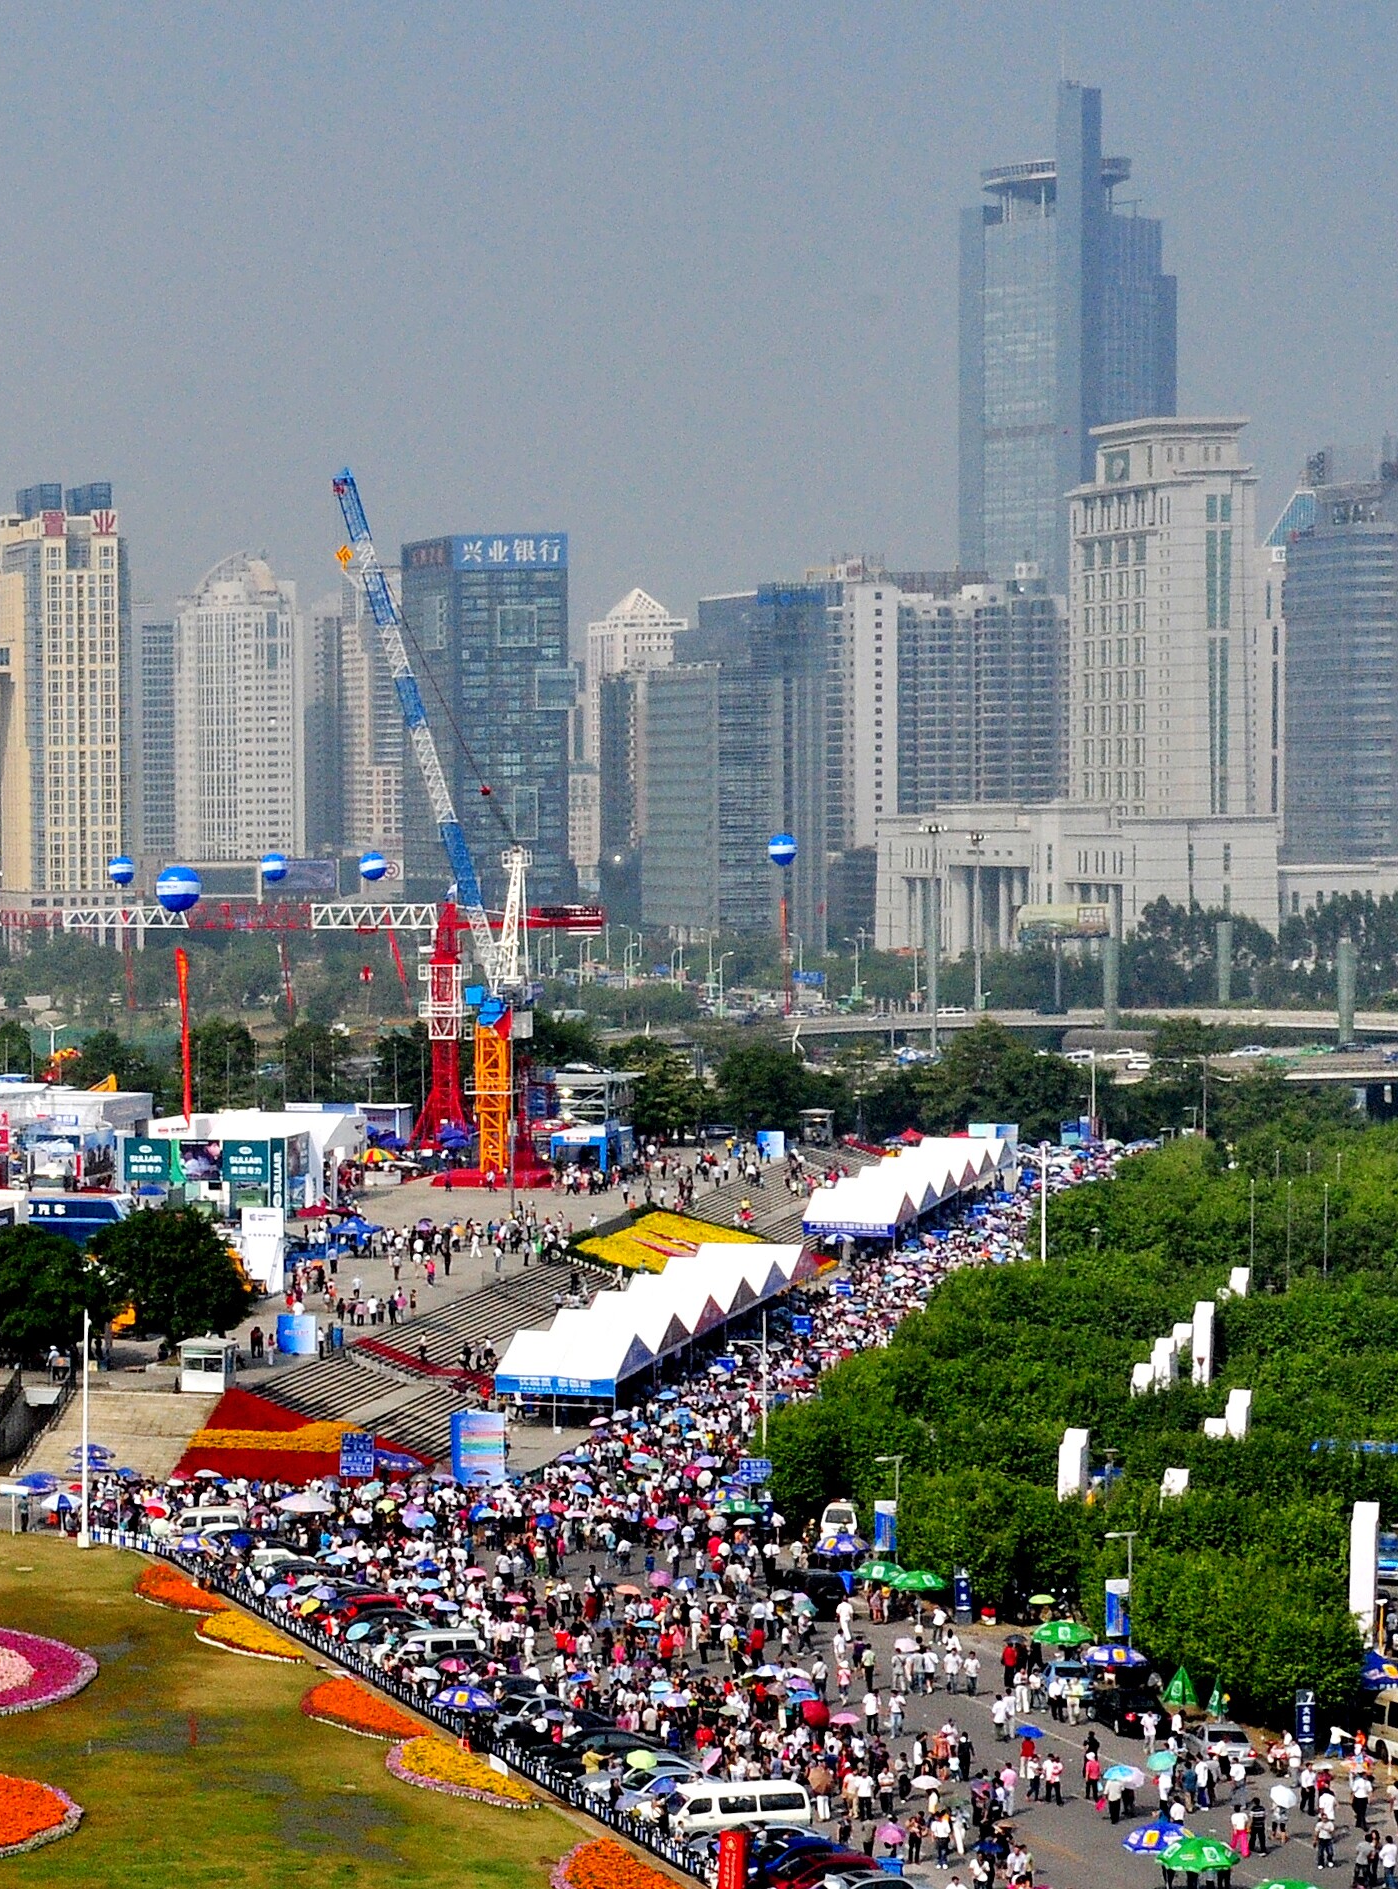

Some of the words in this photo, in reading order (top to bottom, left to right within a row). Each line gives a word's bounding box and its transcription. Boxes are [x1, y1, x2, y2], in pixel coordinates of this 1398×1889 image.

[41, 509, 118, 537] 置业
[461, 538, 561, 563] 兴业银行
[229, 1155, 263, 1165] SULLAIR
[1306, 1691, 1314, 1703] 7
